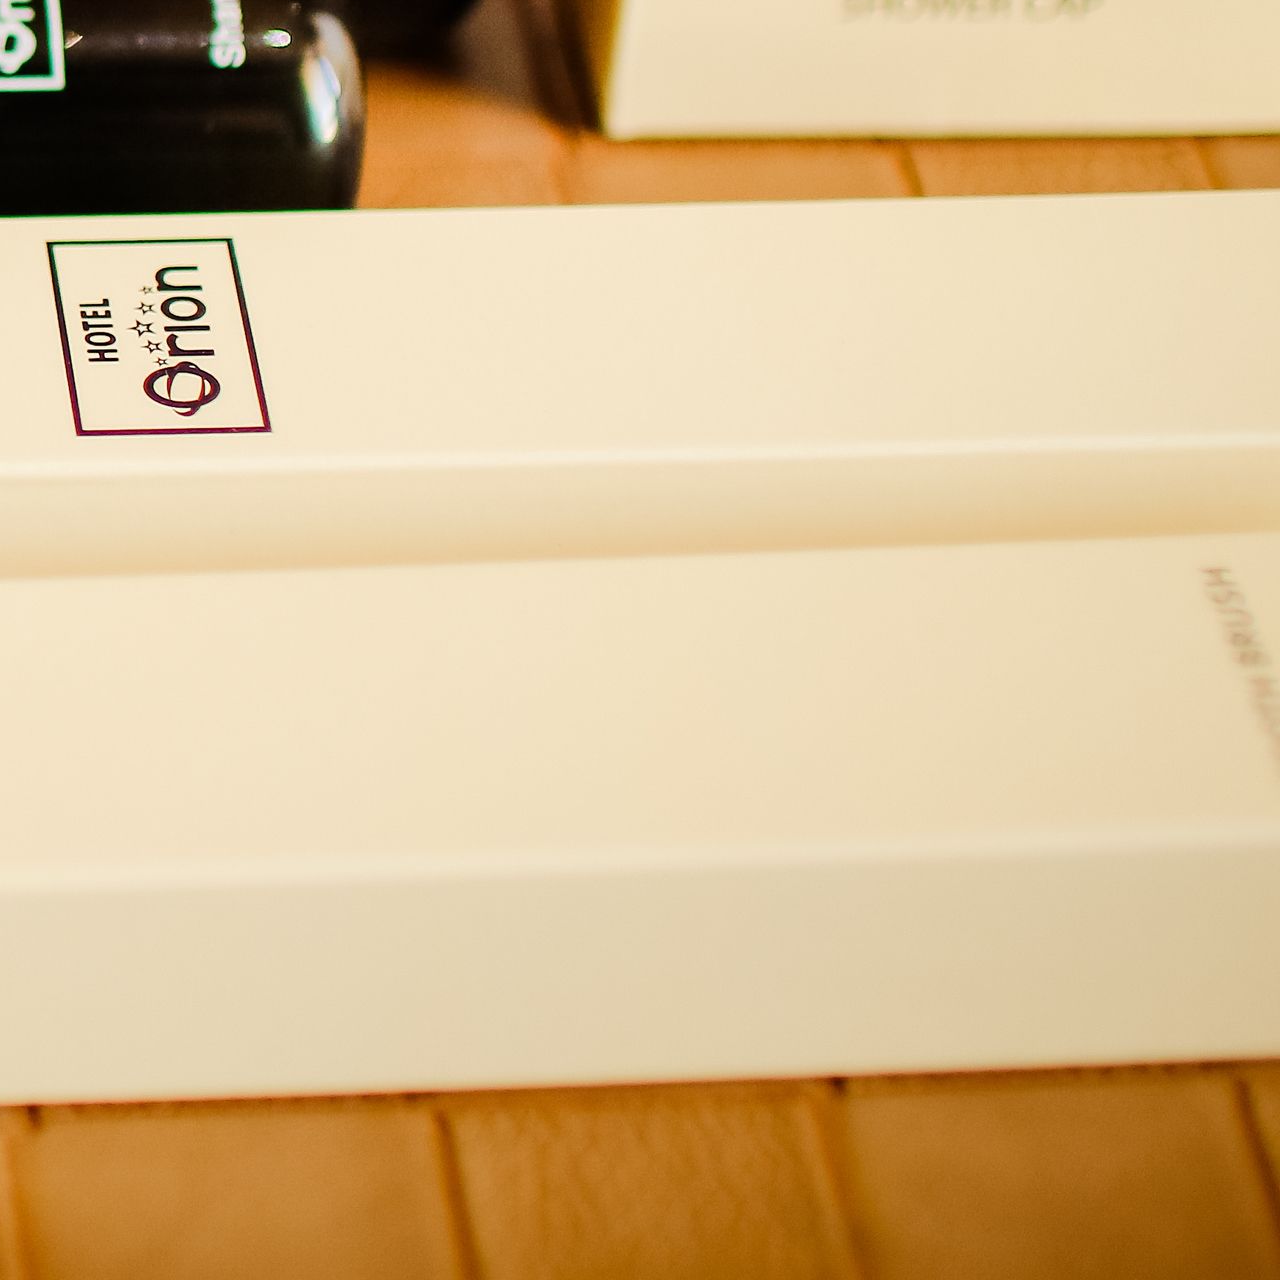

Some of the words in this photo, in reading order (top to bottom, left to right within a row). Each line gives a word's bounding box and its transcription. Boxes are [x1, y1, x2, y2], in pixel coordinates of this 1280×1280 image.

[79, 298, 119, 362] HOTEL
[143, 266, 221, 417] Orion
[1197, 566, 1272, 668] BRUSH
